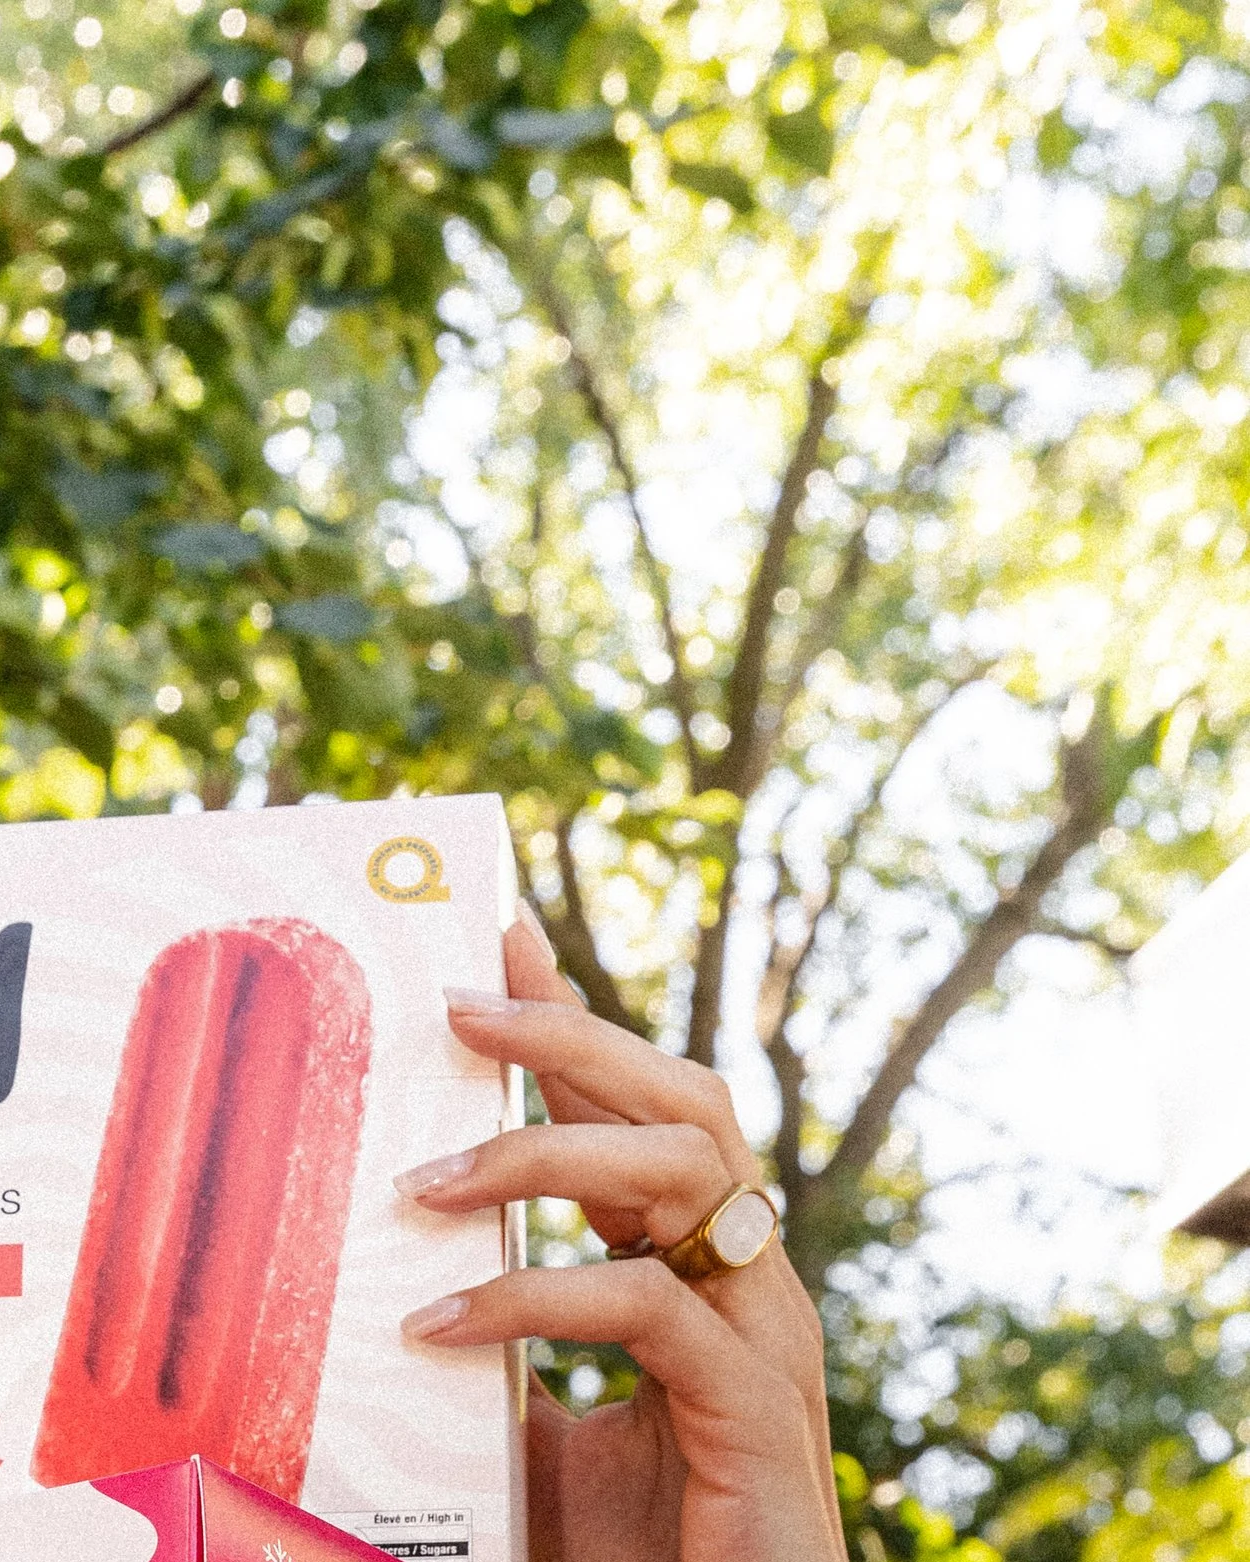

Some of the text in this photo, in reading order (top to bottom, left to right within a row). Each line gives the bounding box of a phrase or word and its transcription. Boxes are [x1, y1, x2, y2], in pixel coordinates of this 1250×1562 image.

[374, 1513, 401, 1524] Élevé
[427, 1513, 450, 1524] High
[454, 1512, 464, 1522] in
[376, 1546, 410, 1556] cres
[420, 1545, 458, 1556] Sugars
